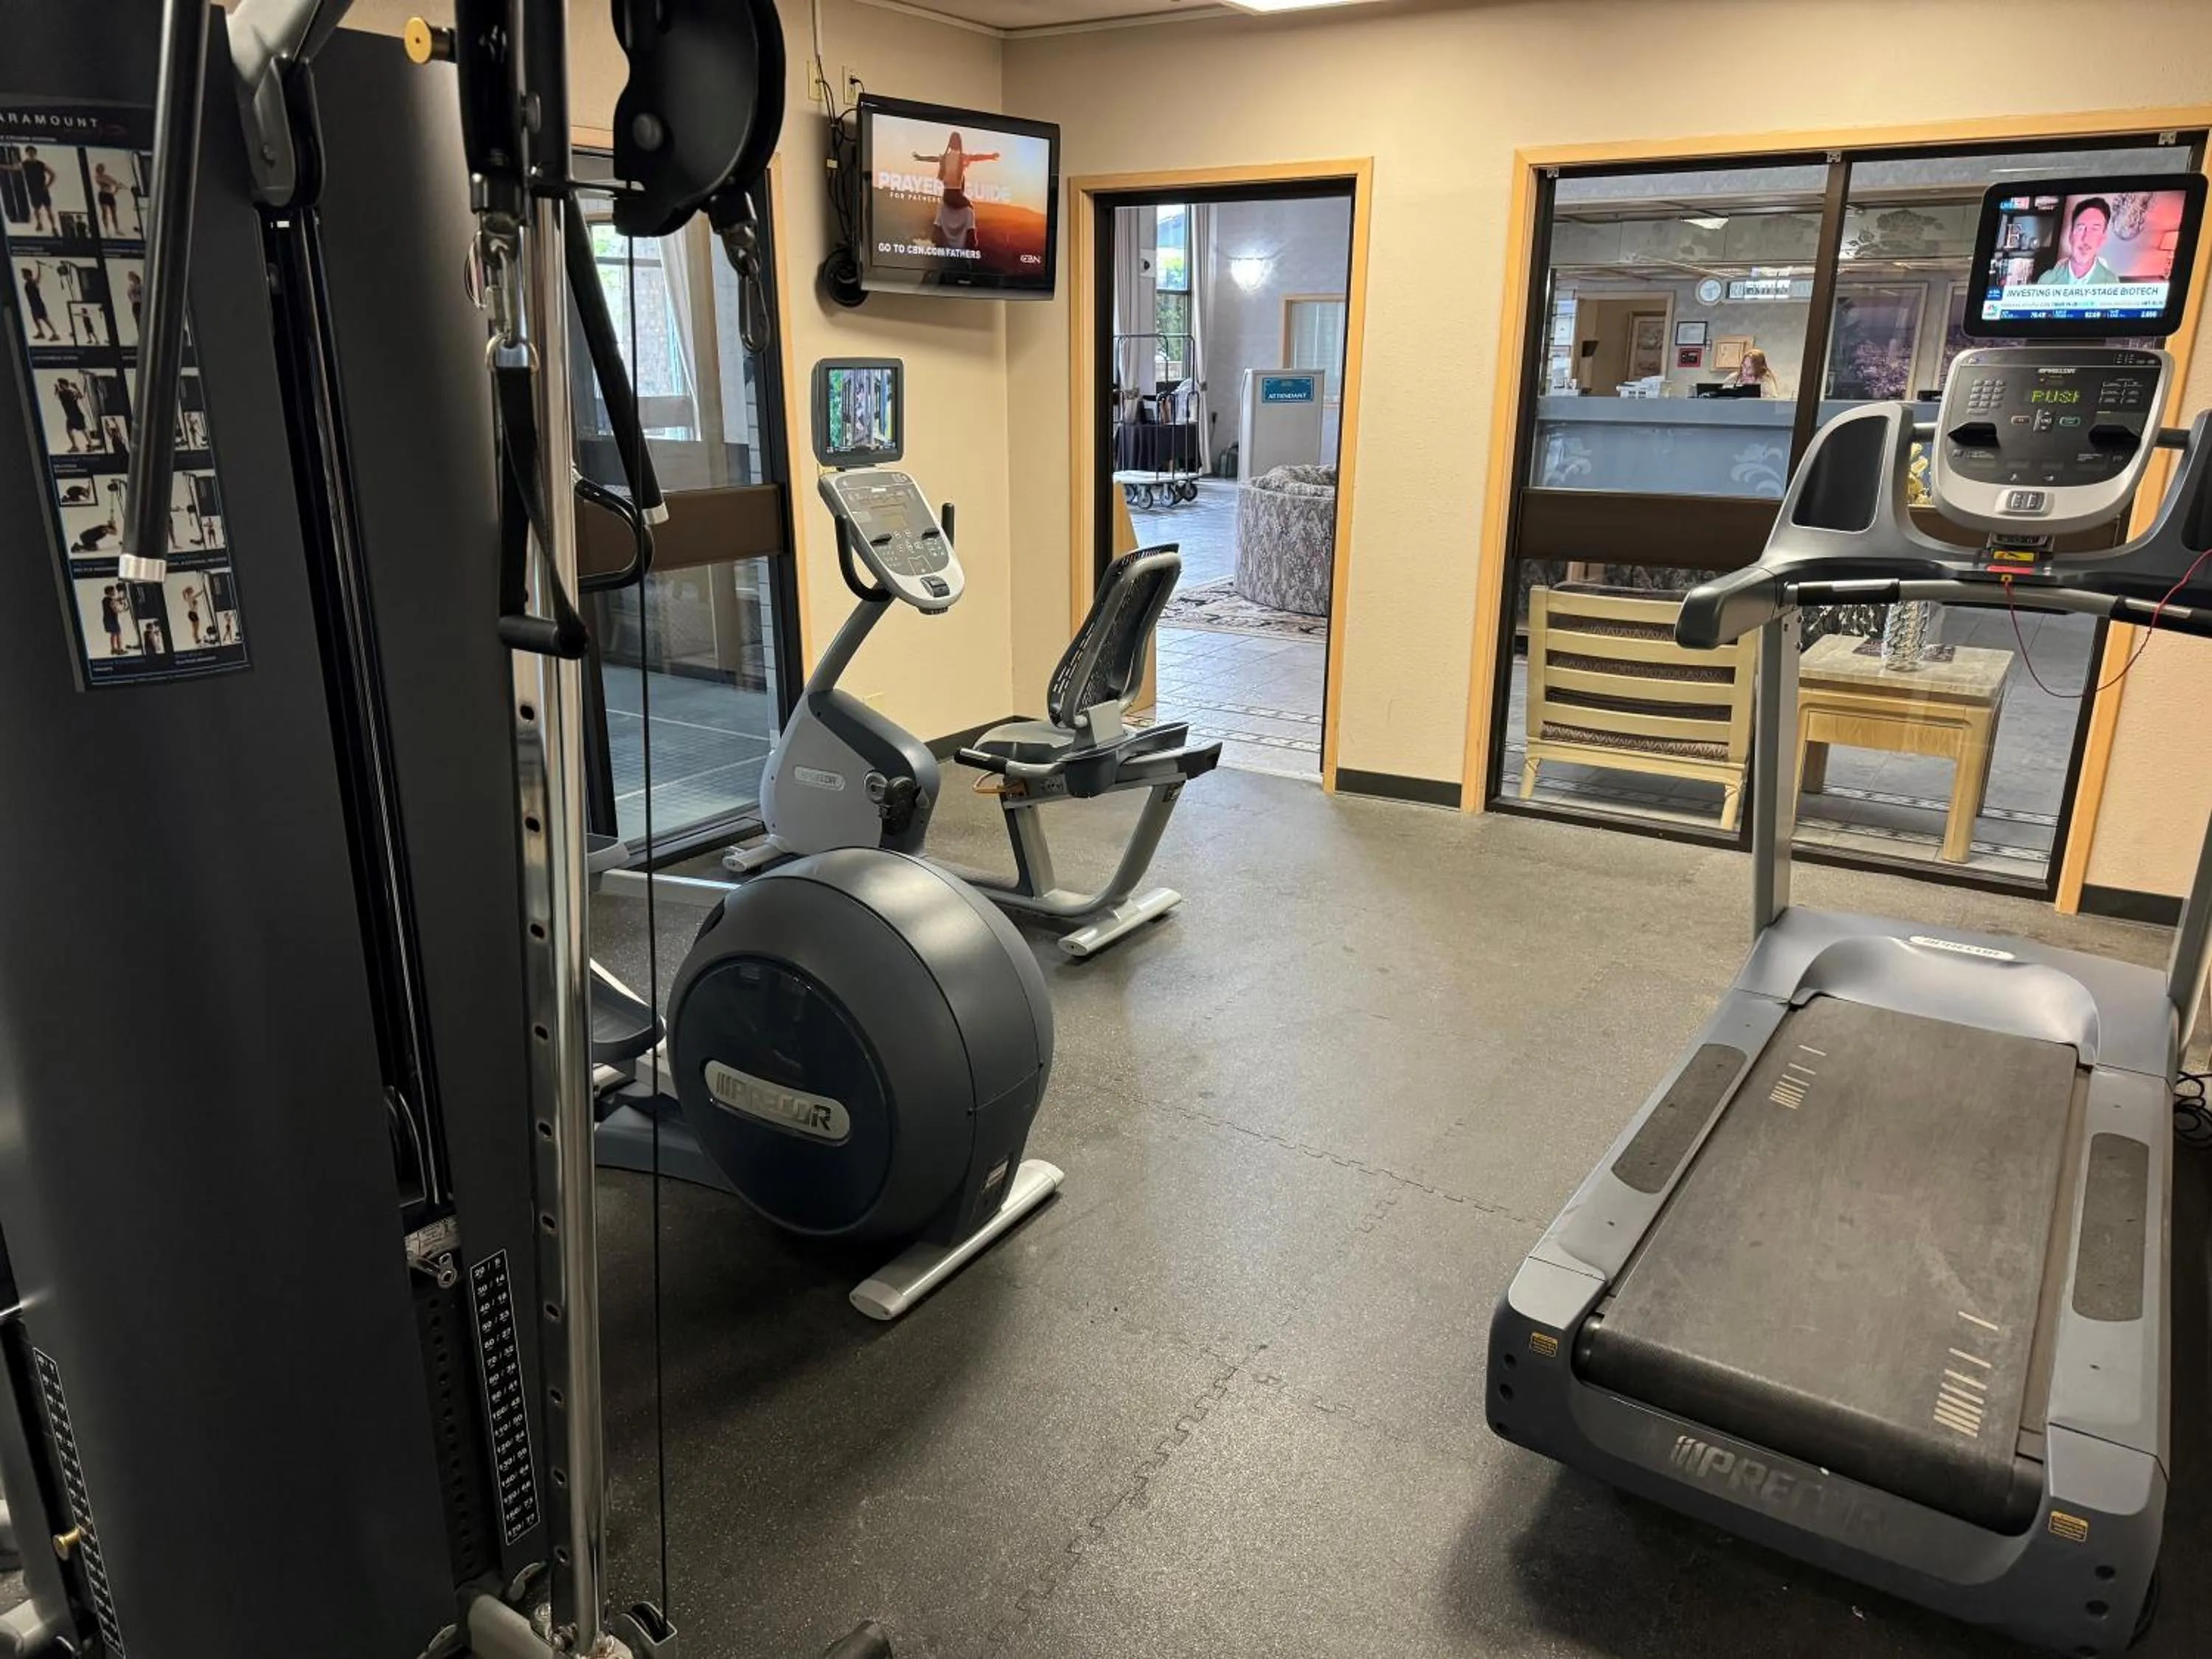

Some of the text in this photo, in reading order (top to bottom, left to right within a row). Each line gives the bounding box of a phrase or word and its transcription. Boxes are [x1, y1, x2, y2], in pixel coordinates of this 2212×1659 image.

[0, 112, 98, 128] ARAMOUNT
[878, 172, 1012, 202] PRAYER GUIDE
[878, 242, 891, 253] GO
[894, 243, 905, 254] TO
[2006, 288, 2051, 297] INVESTING
[2052, 288, 2061, 296] IN
[2062, 288, 2118, 296] EARLY-STAGE
[2120, 287, 2159, 296] BIOTECH
